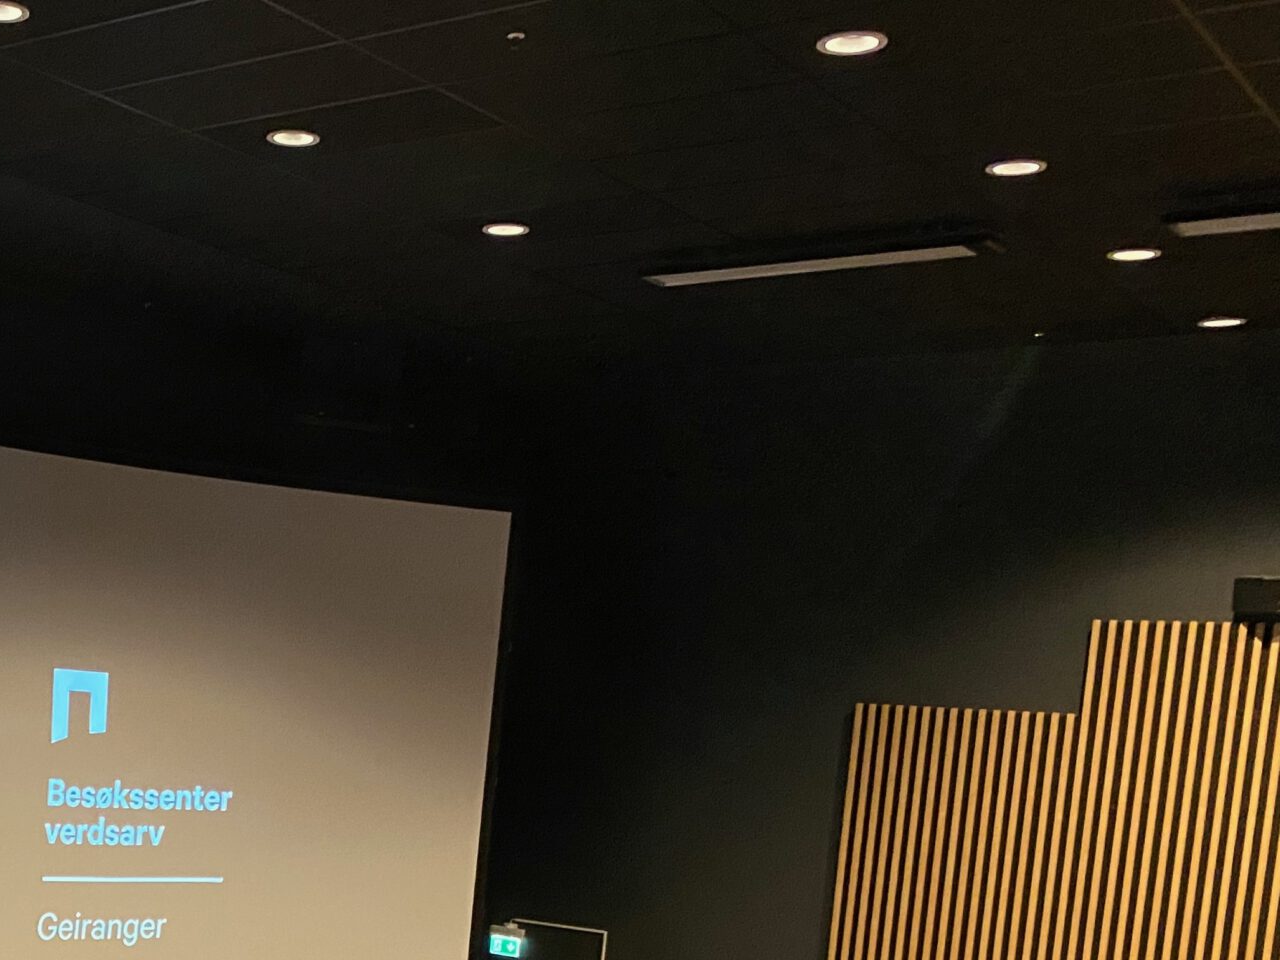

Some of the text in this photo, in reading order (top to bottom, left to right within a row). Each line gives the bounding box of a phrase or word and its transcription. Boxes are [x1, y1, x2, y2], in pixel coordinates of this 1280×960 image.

[47, 777, 233, 812] Besøkssenter
[45, 818, 166, 847] verdsarv
[37, 910, 167, 947] Geiranger
